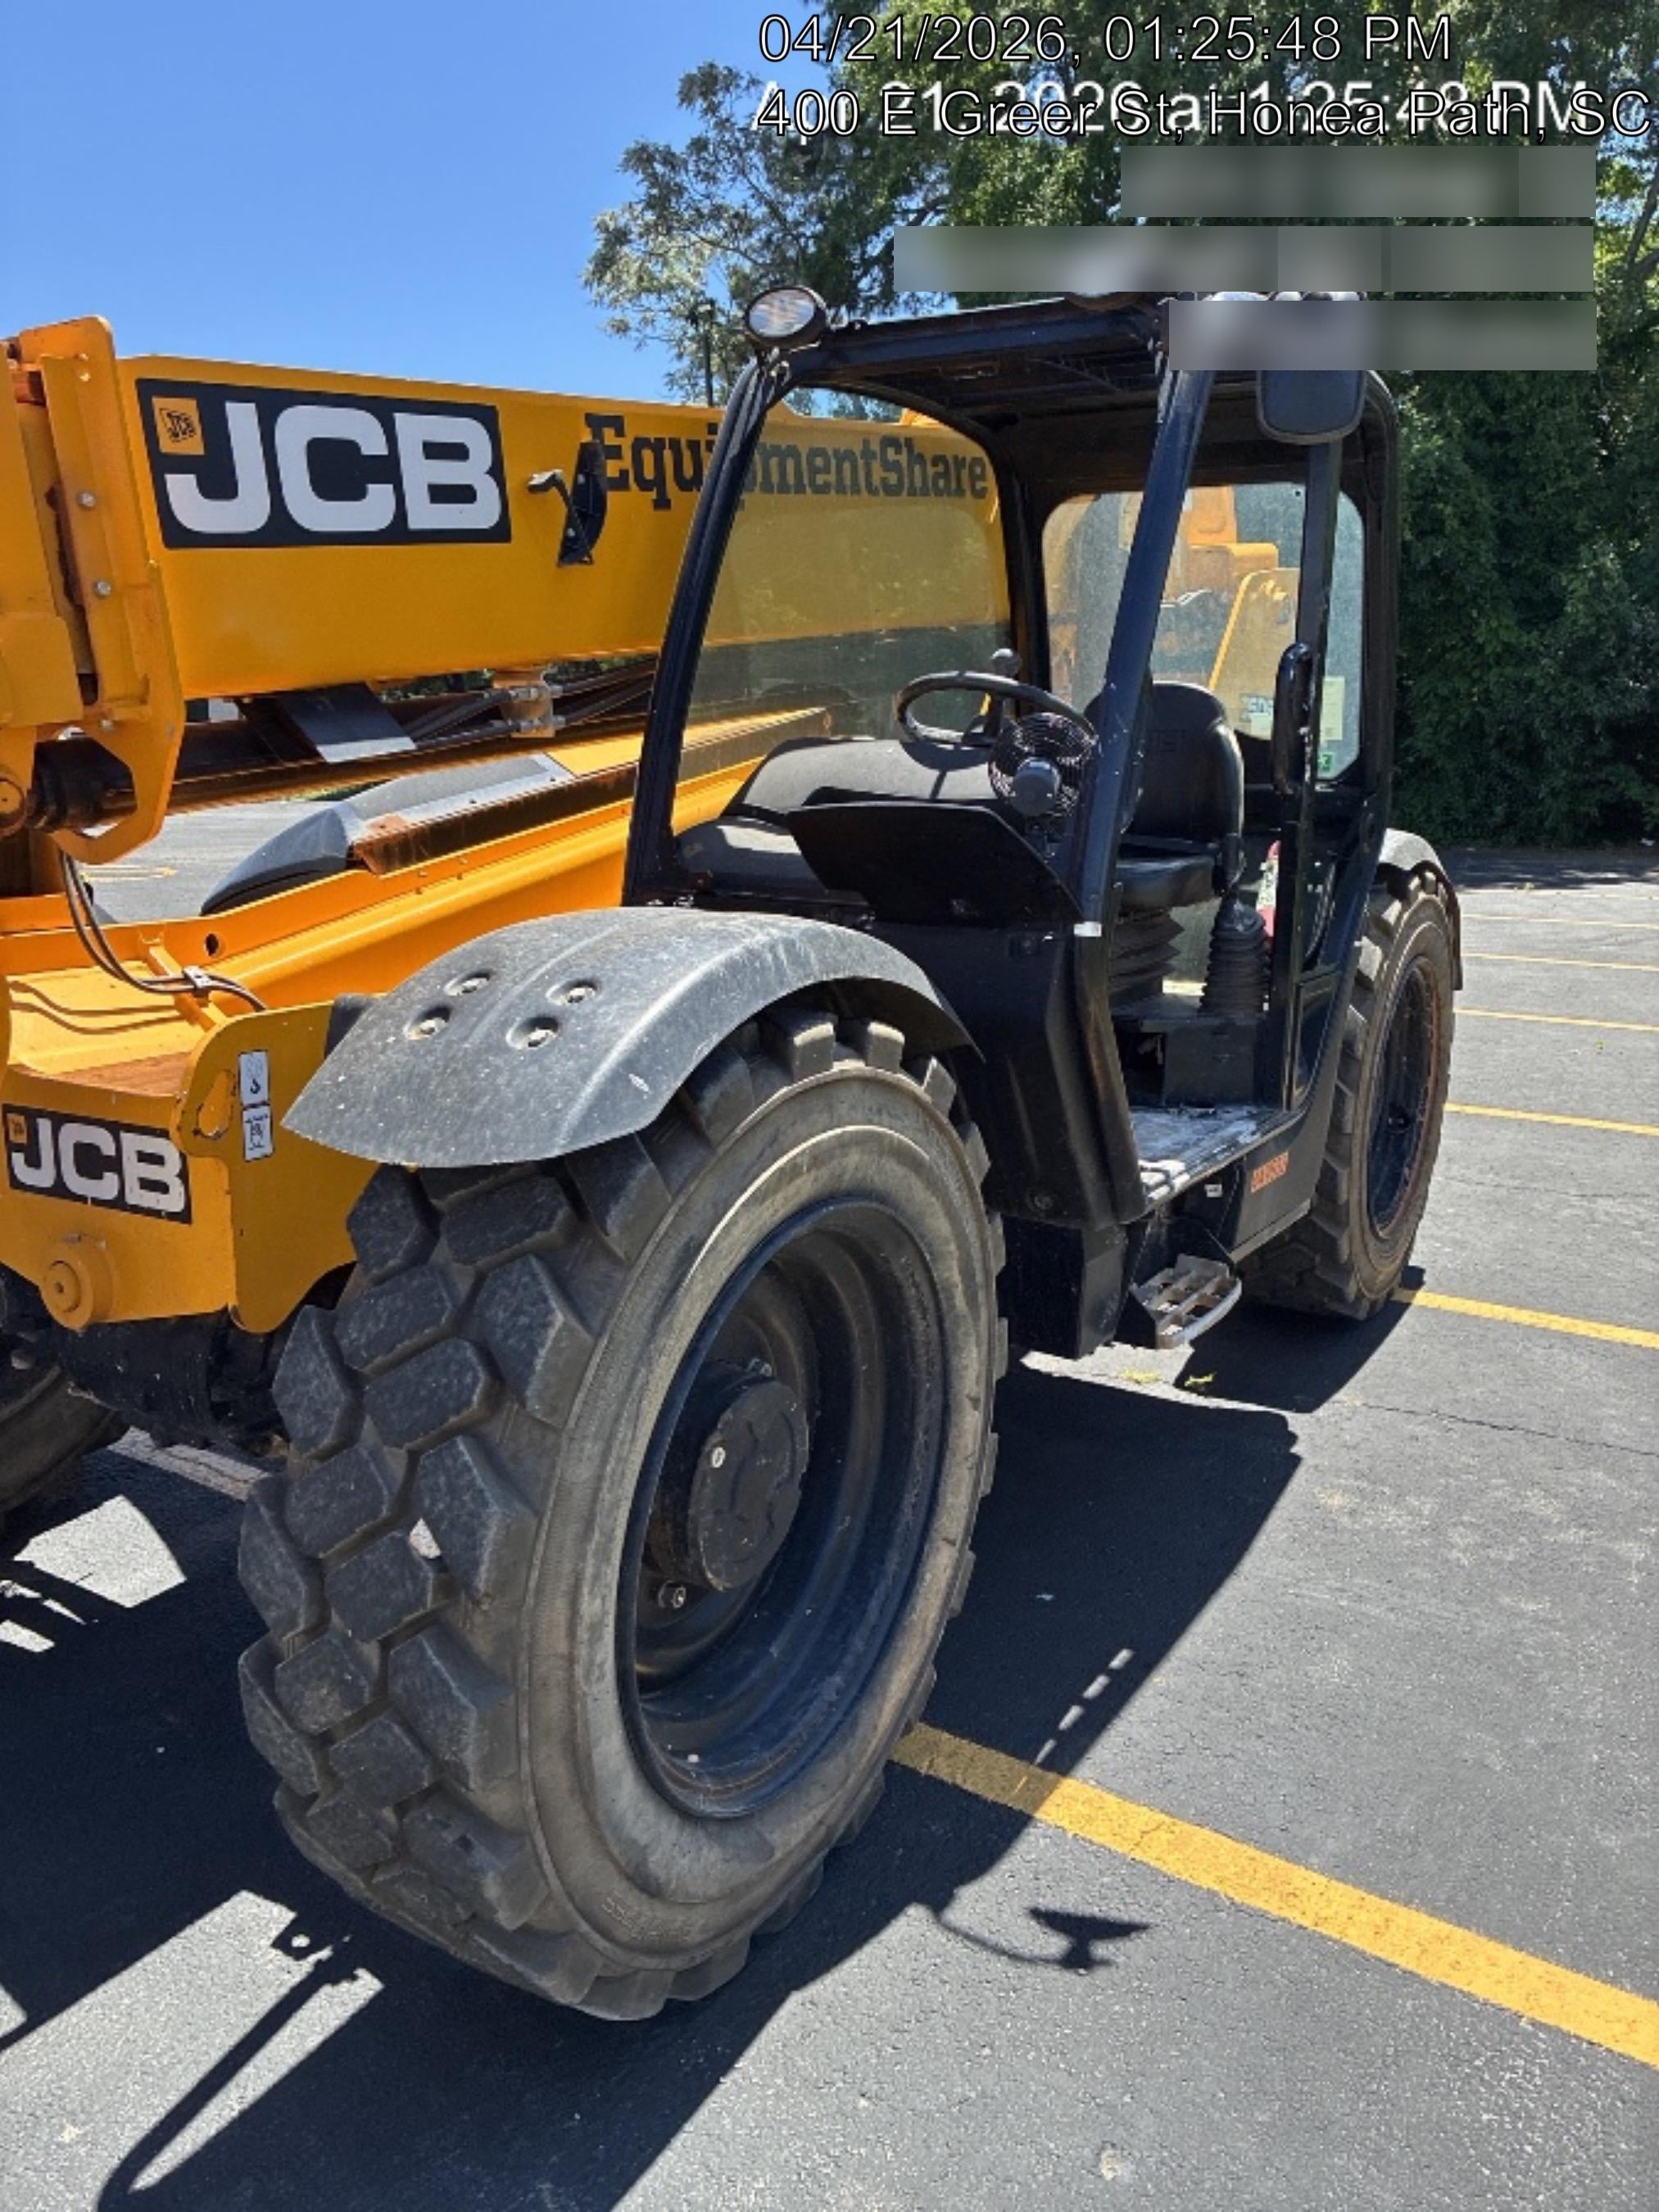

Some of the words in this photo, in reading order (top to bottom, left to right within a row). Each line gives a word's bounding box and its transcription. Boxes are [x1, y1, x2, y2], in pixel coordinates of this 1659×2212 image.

[163, 401, 503, 534] JCB
[585, 412, 989, 512] EqumentShare
[11, 1117, 186, 1213] JCB
